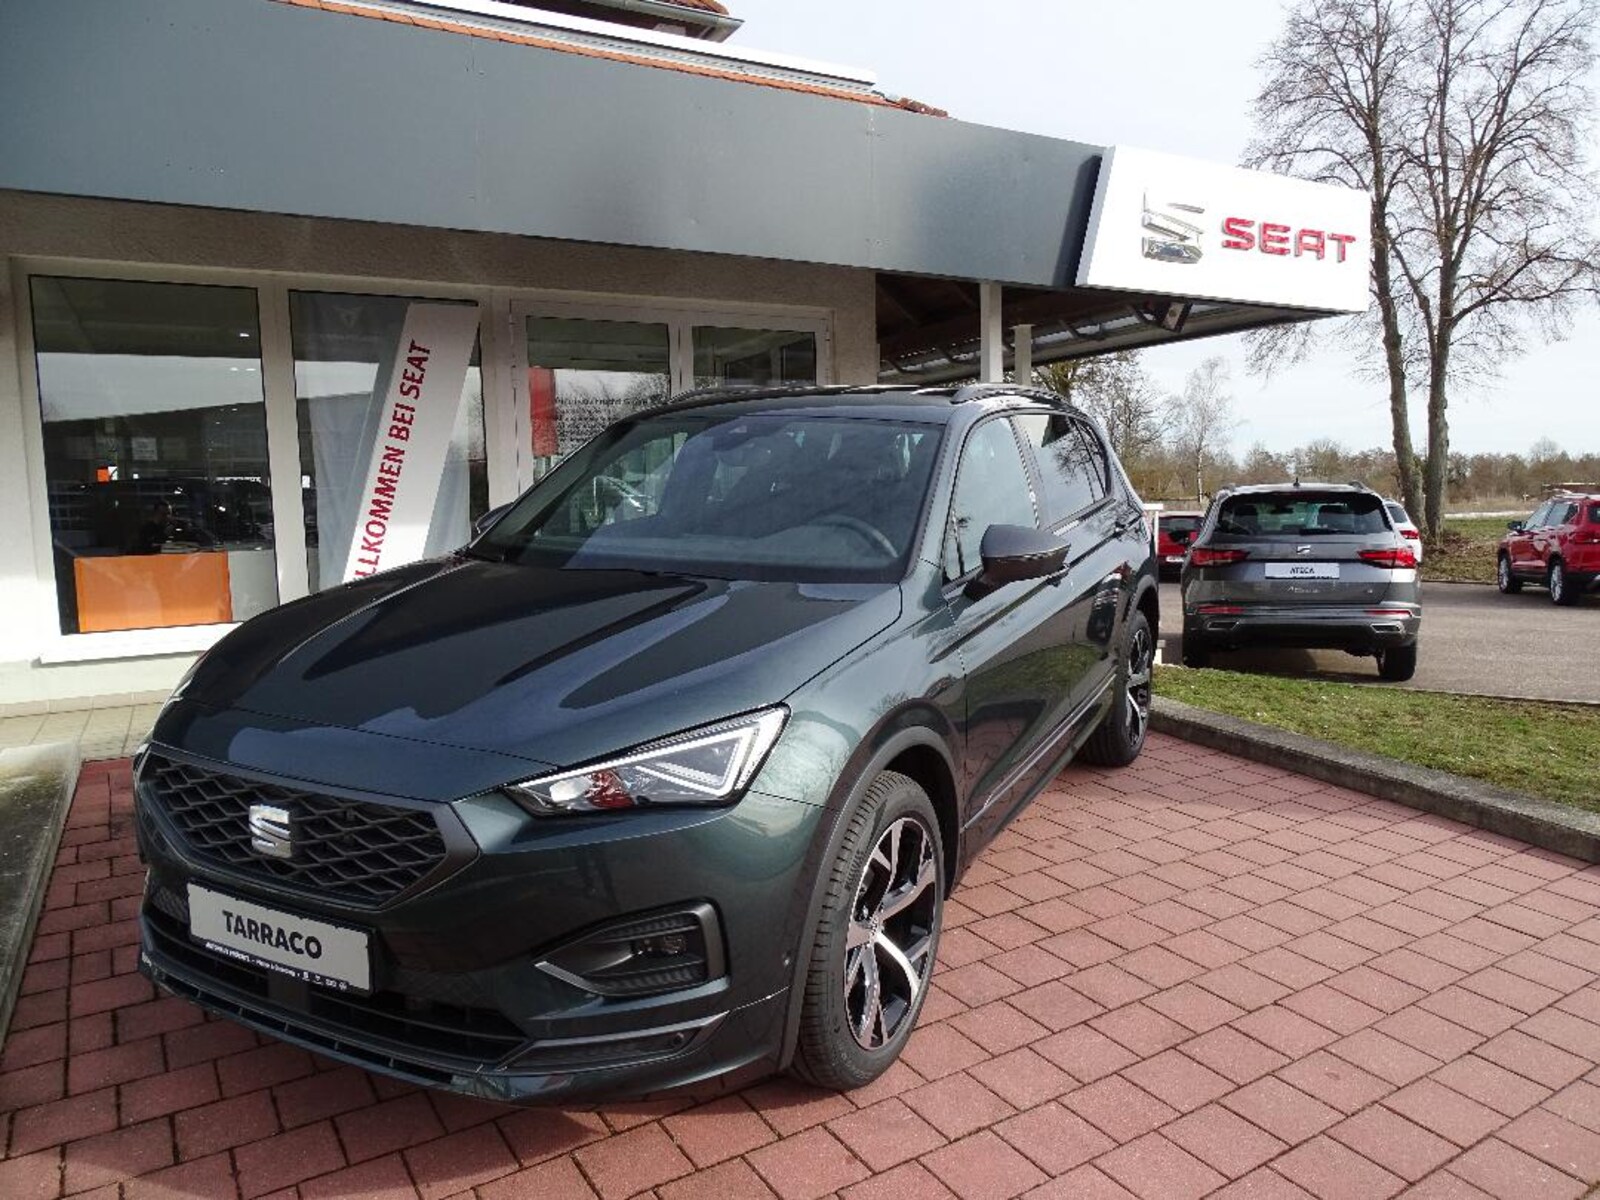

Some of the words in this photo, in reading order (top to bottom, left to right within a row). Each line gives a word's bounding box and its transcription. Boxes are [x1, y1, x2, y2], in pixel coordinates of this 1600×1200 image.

[1221, 216, 1356, 262] SEAT
[400, 339, 431, 400] SEAT
[388, 403, 416, 442] BEI
[354, 445, 405, 577] LLKOMMEN
[222, 910, 322, 959] TARRACO
